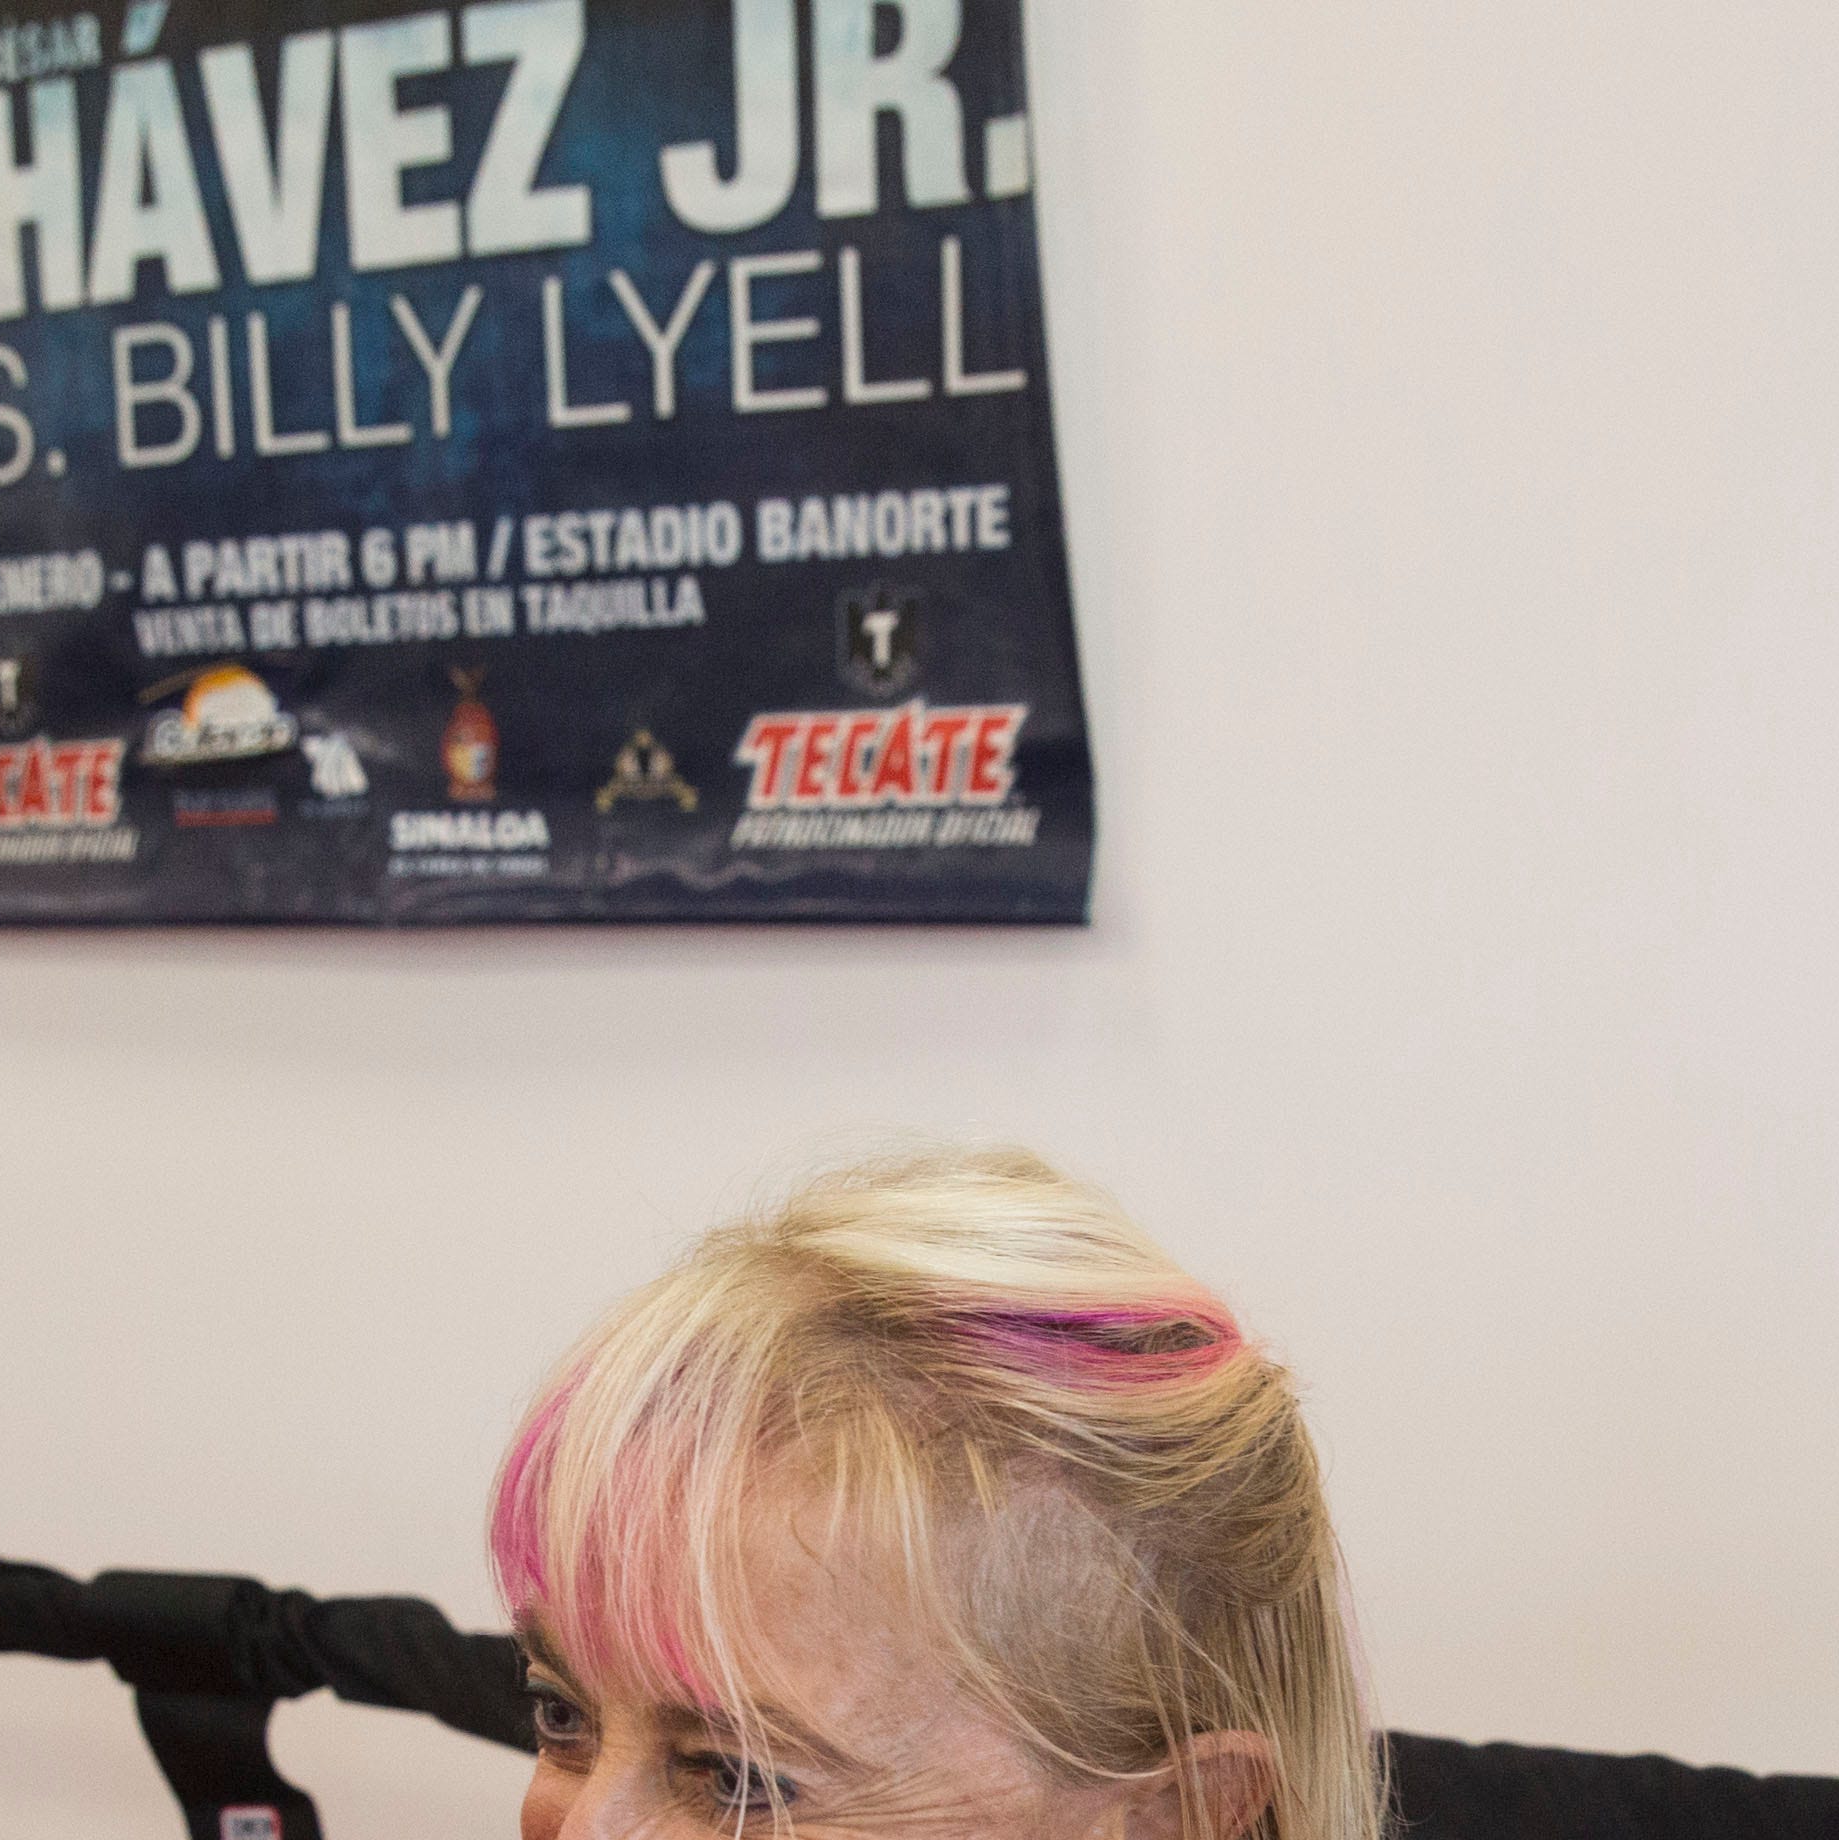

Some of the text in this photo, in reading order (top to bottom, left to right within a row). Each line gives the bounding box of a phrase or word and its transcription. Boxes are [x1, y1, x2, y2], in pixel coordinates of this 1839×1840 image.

[660, 0, 1030, 234] JR.
[112, 285, 485, 470] BILLY
[542, 234, 1028, 428] LYELL
[141, 543, 177, 602] A
[182, 529, 353, 600] PARTIR
[361, 527, 398, 588] 6
[404, 519, 478, 586] PM
[521, 501, 743, 578] ESTADIO
[756, 484, 1012, 565] BANORTE
[132, 573, 706, 658] VENTA DE BOLETOS EN TAQUILLA
[738, 698, 1025, 807] TECATE
[391, 811, 551, 851] SINALOA
